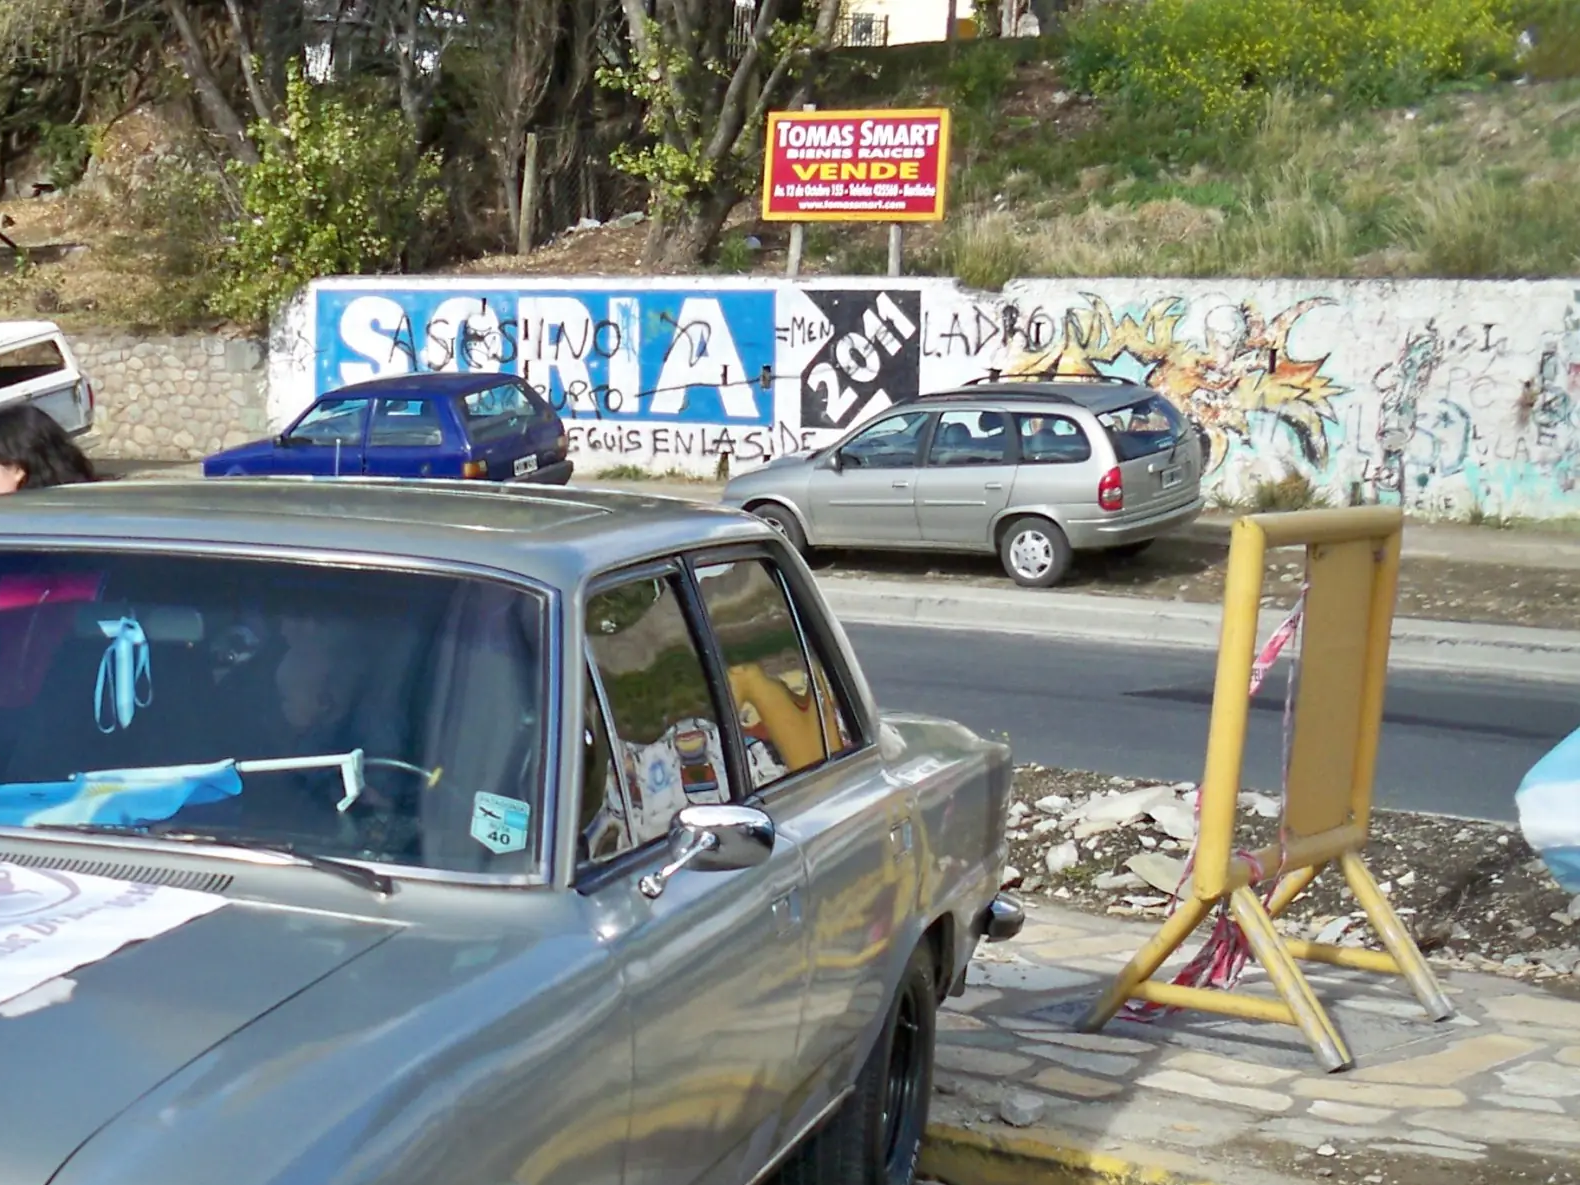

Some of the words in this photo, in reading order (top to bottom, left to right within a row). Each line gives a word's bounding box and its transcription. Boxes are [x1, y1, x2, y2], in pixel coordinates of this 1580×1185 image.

[777, 121, 854, 147] TOMAS
[860, 120, 939, 146] SMART
[786, 149, 853, 160] BIENES
[858, 148, 925, 159] RAICES
[792, 162, 920, 181] VENDE
[339, 296, 760, 417] SORIA
[806, 291, 917, 424] 2011
